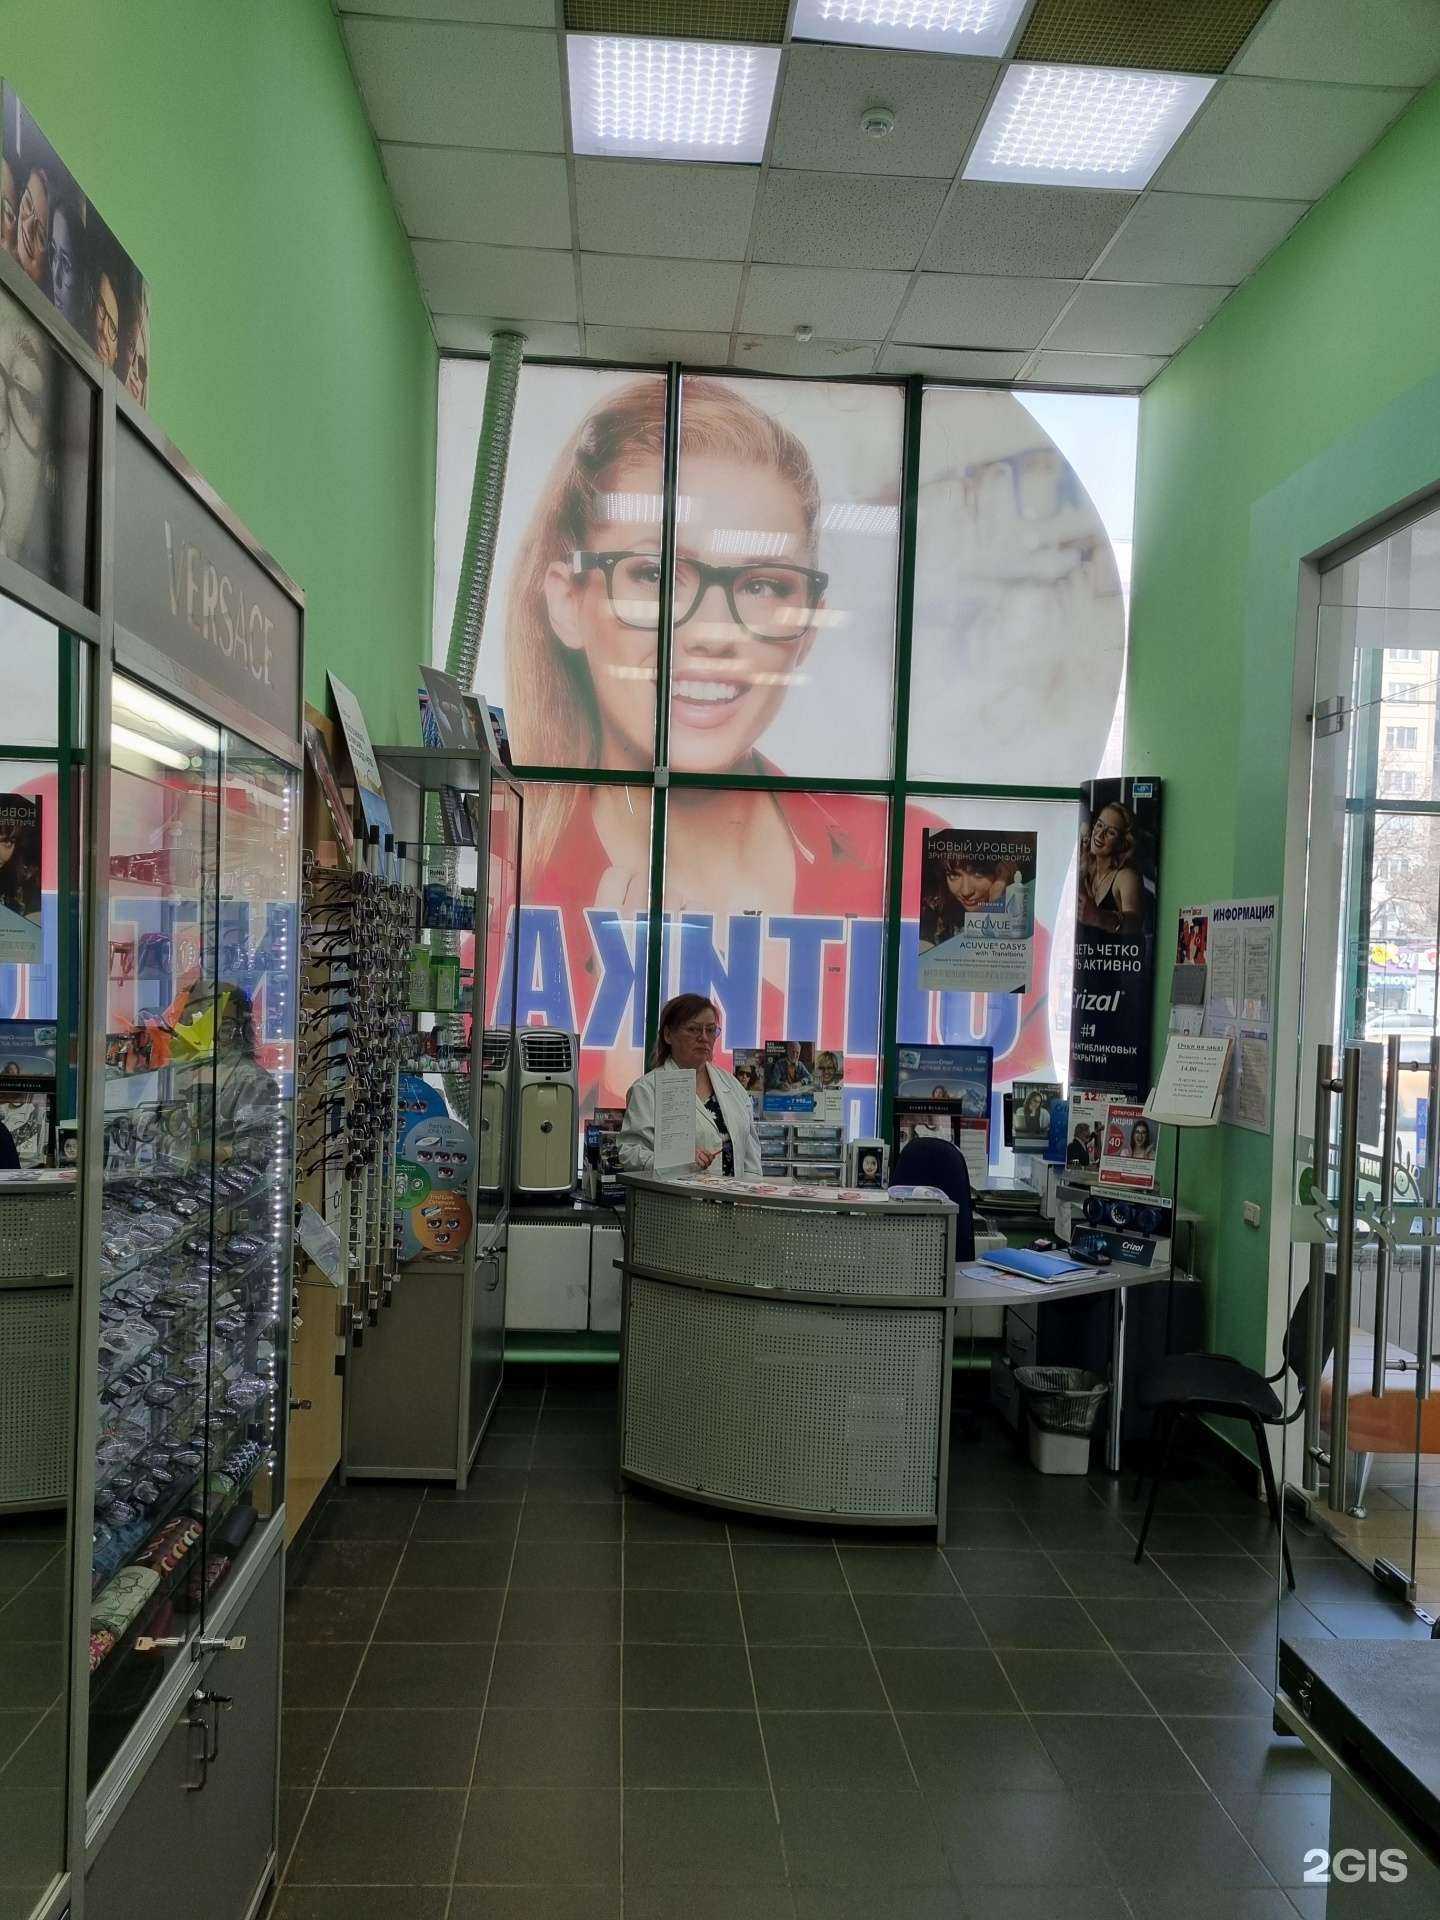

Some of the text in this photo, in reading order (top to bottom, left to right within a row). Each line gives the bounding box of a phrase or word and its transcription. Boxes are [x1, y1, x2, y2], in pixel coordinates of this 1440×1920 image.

[165, 519, 273, 685] VERSACE
[928, 839, 1032, 854] НОВЫЙ УРОВЕНЬ
[927, 851, 985, 861] ЗРИТЕЛЬНОГО
[1213, 904, 1275, 922] ИНФОРМАЦИЯ
[967, 919, 1010, 931] ACUVUE
[1000, 942, 1027, 951] OASYS
[1074, 943, 1139, 957] ДЕТЬ ЧЕТКО
[975, 950, 989, 958] with
[1083, 960, 1142, 973] АКТИВНО
[1080, 1023, 1096, 1038] #1
[1072, 1053, 1107, 1064] ОКРЫТИЙ
[1108, 1137, 1121, 1147] 40
